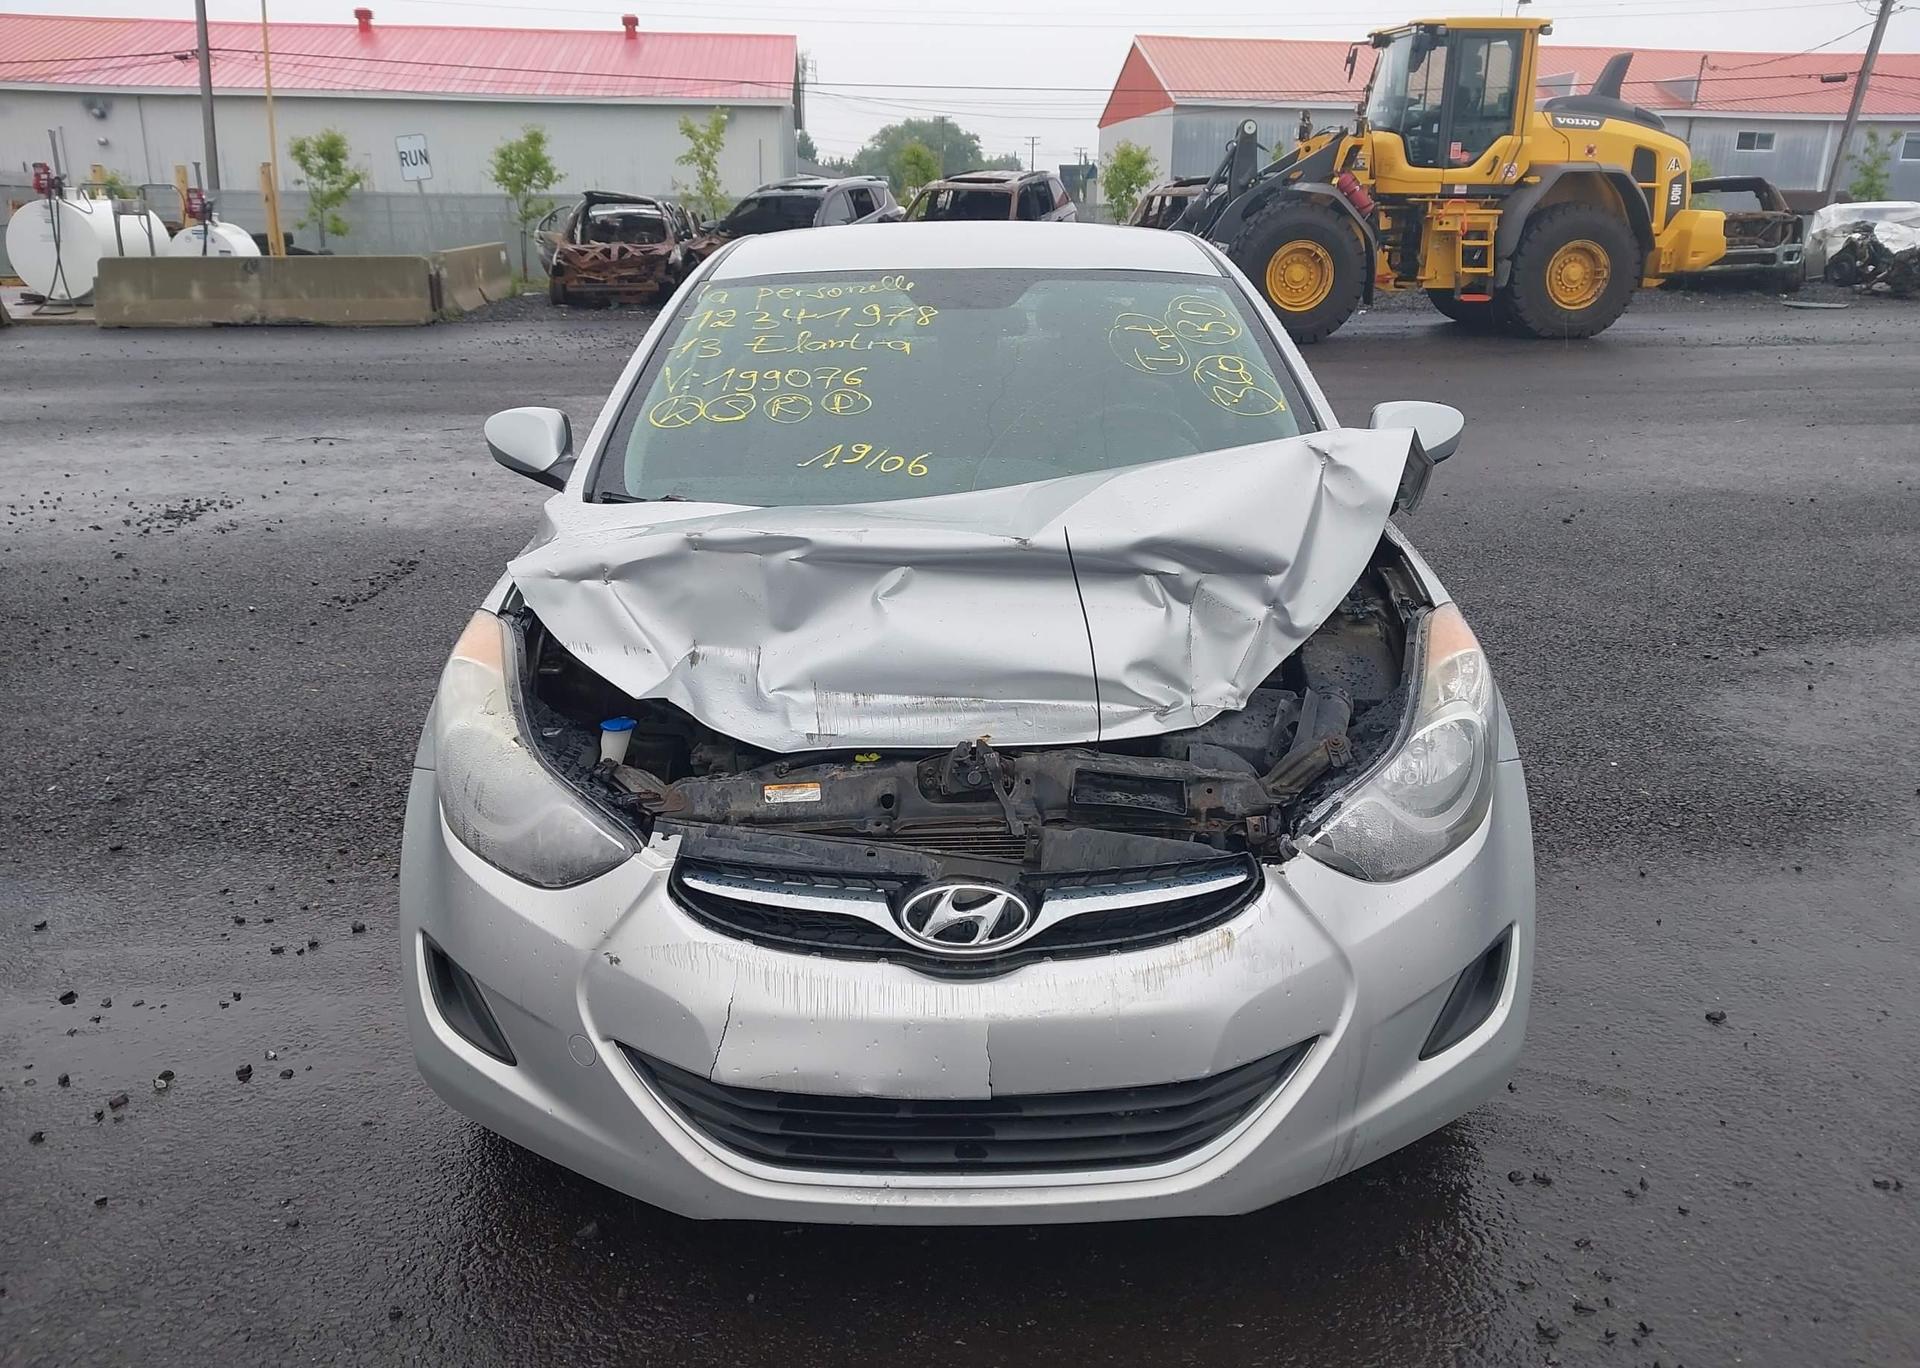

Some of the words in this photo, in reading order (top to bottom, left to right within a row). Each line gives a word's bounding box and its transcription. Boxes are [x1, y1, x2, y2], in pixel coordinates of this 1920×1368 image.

[1555, 116, 1600, 126] VOLVO
[400, 149, 429, 167] RUN
[1670, 183, 1682, 206] L90H
[668, 337, 722, 358] 13
[744, 330, 912, 356] Elantra
[796, 443, 933, 477] 19/06
